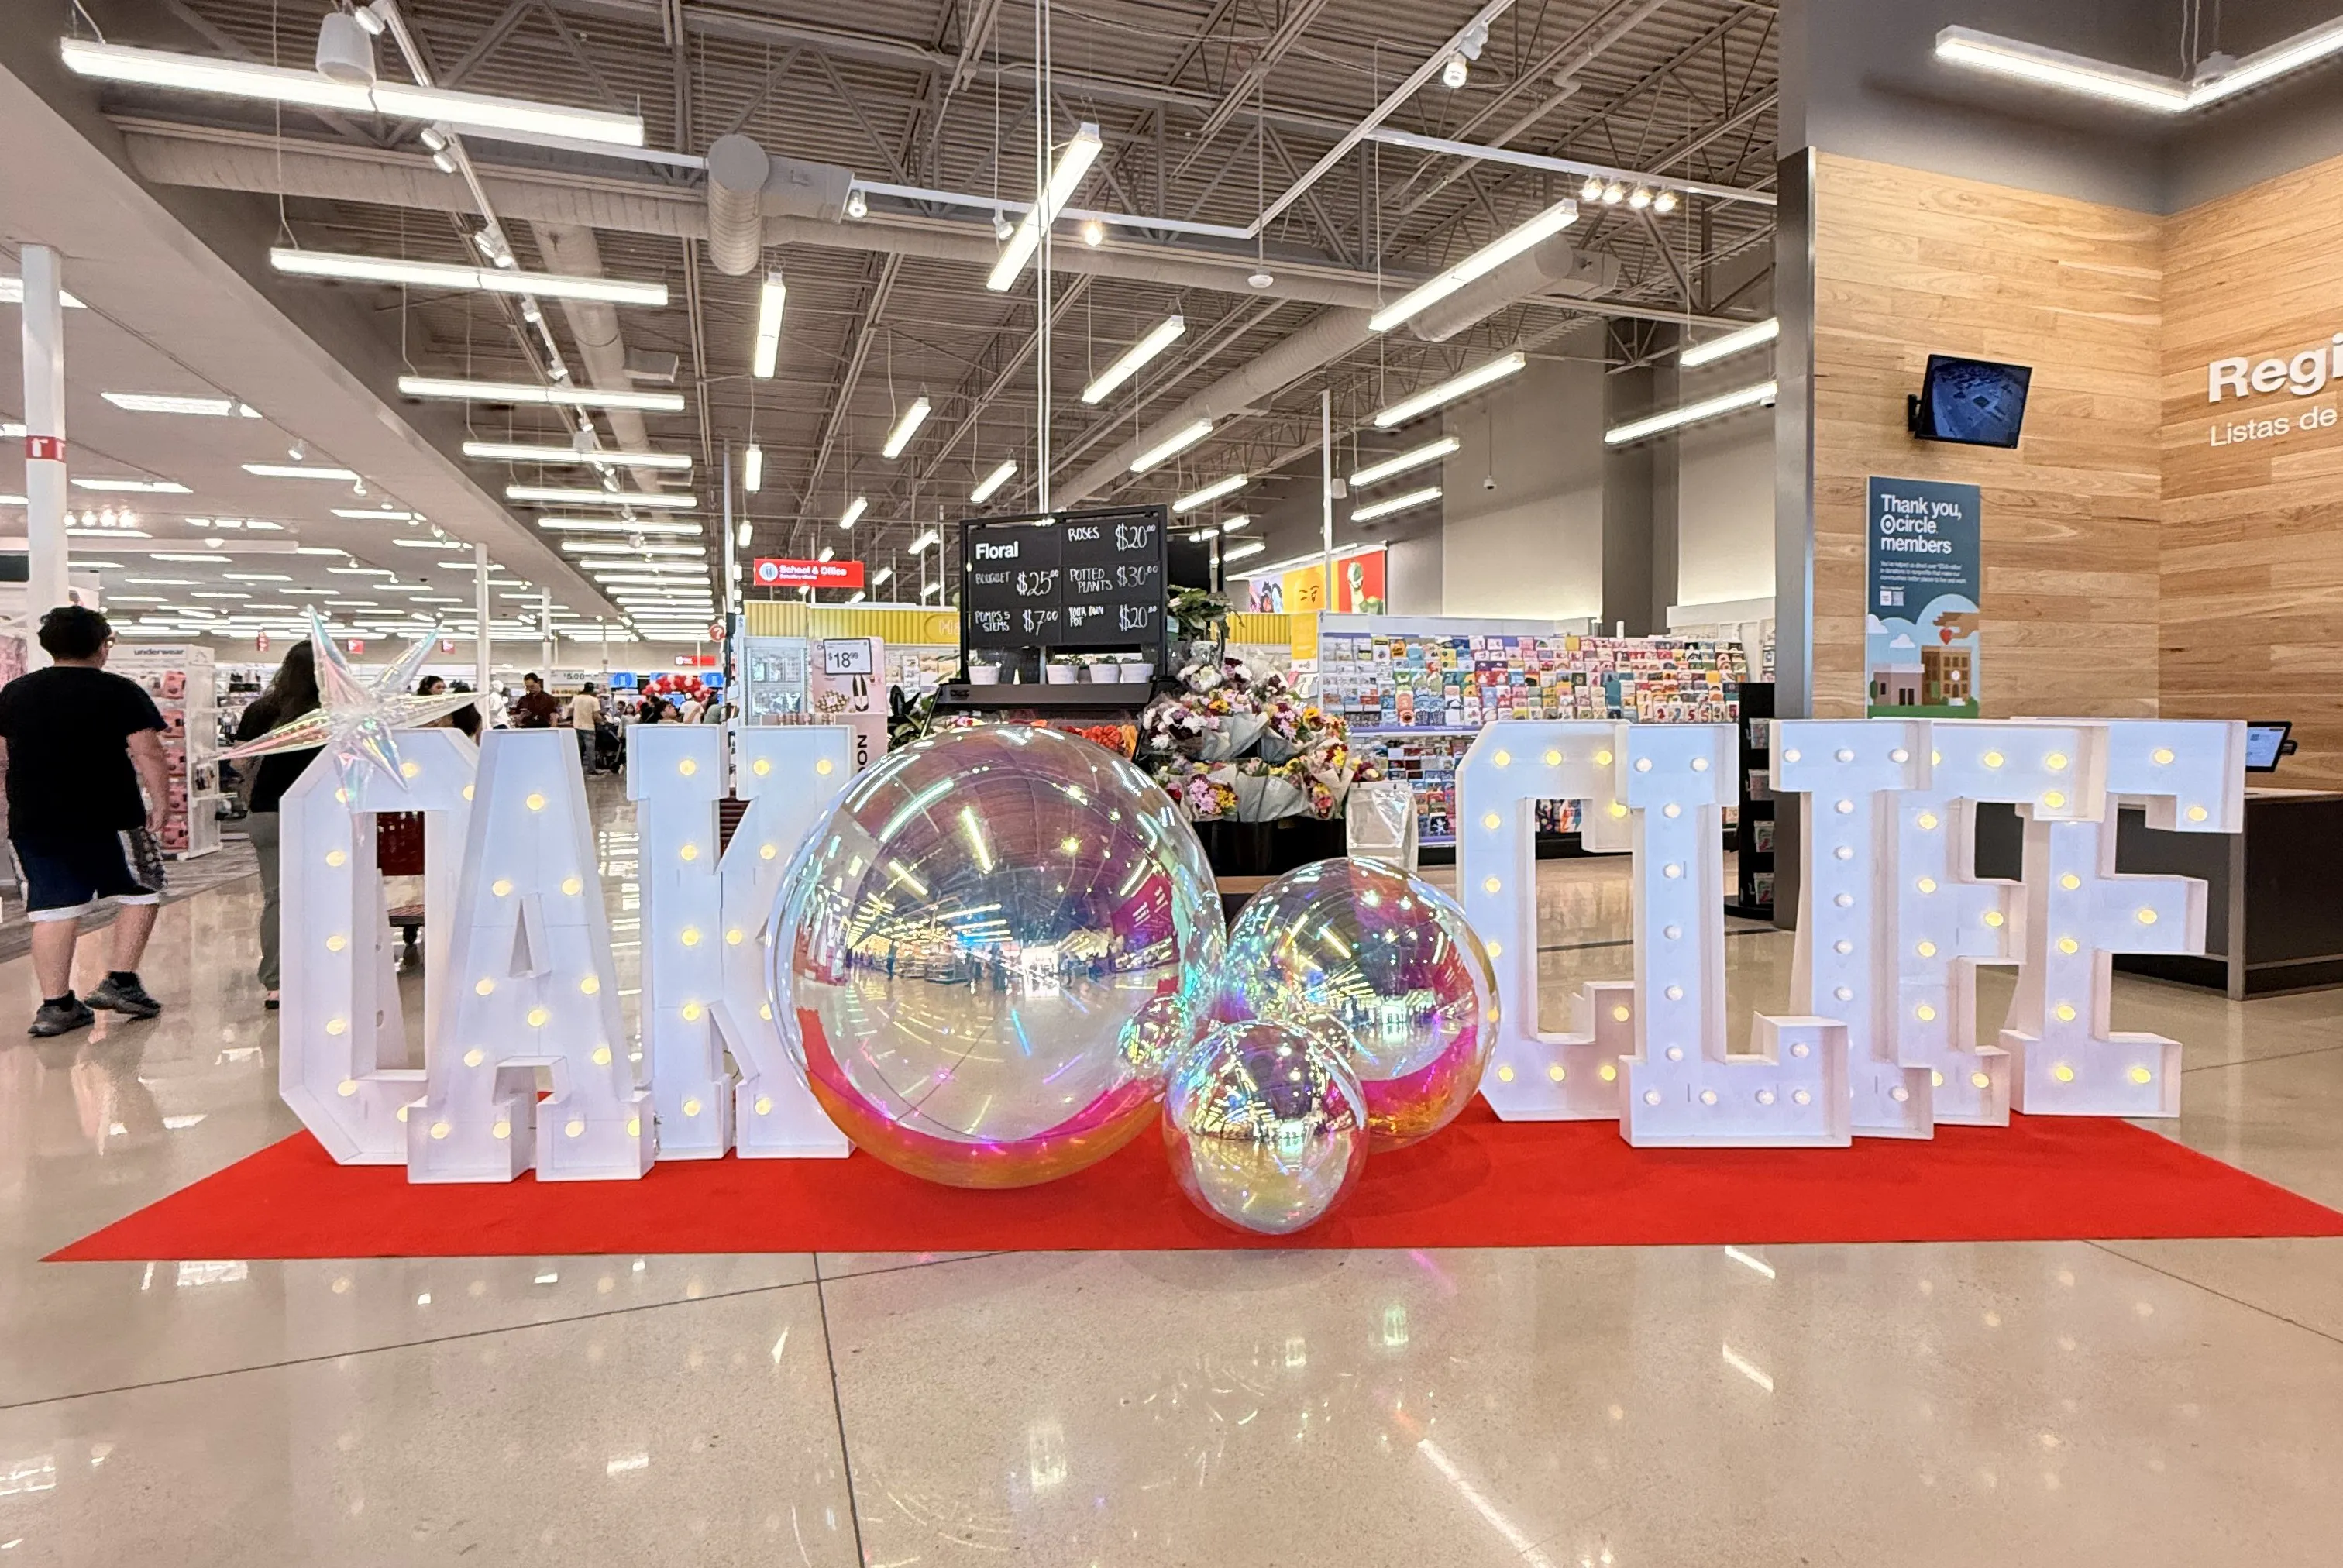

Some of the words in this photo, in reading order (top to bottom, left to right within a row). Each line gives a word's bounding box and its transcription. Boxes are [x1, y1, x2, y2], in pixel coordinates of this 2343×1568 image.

[2211, 418, 2290, 447] Listas
[2299, 405, 2338, 431] de
[1880, 493, 1928, 514] Thank
[1931, 501, 1962, 521] you,
[1068, 526, 1100, 542] ROSES
[975, 540, 1019, 560] Floral
[1880, 535, 1952, 554] members
[1069, 567, 1105, 582] POTTED
[1077, 579, 1113, 594] PLANTS
[279, 725, 857, 1184] OAK
[1454, 717, 2247, 1148] CLIFF
